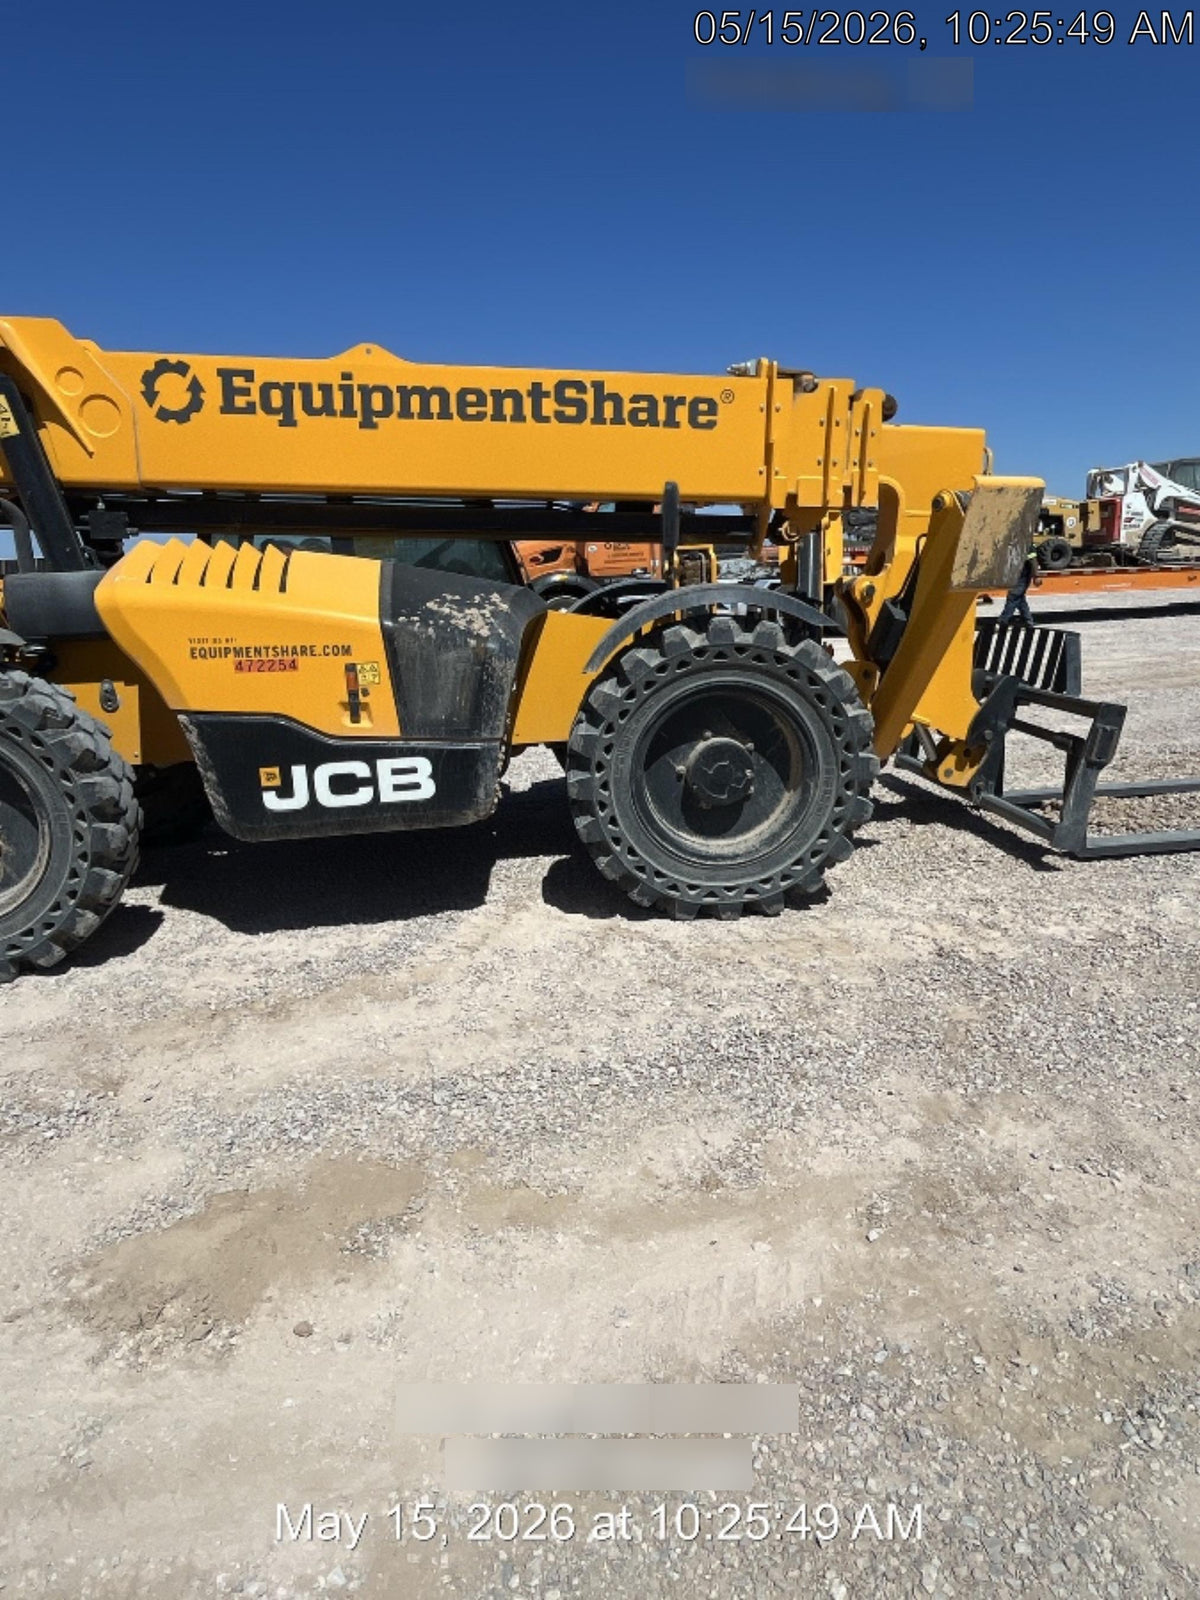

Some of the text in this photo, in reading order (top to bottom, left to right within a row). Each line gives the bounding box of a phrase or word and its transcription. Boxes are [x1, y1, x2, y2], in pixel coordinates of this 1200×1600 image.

[189, 644, 353, 660] EQUIPMENTSHARE.COM
[234, 658, 298, 673] 472254
[261, 756, 437, 813] JCB
